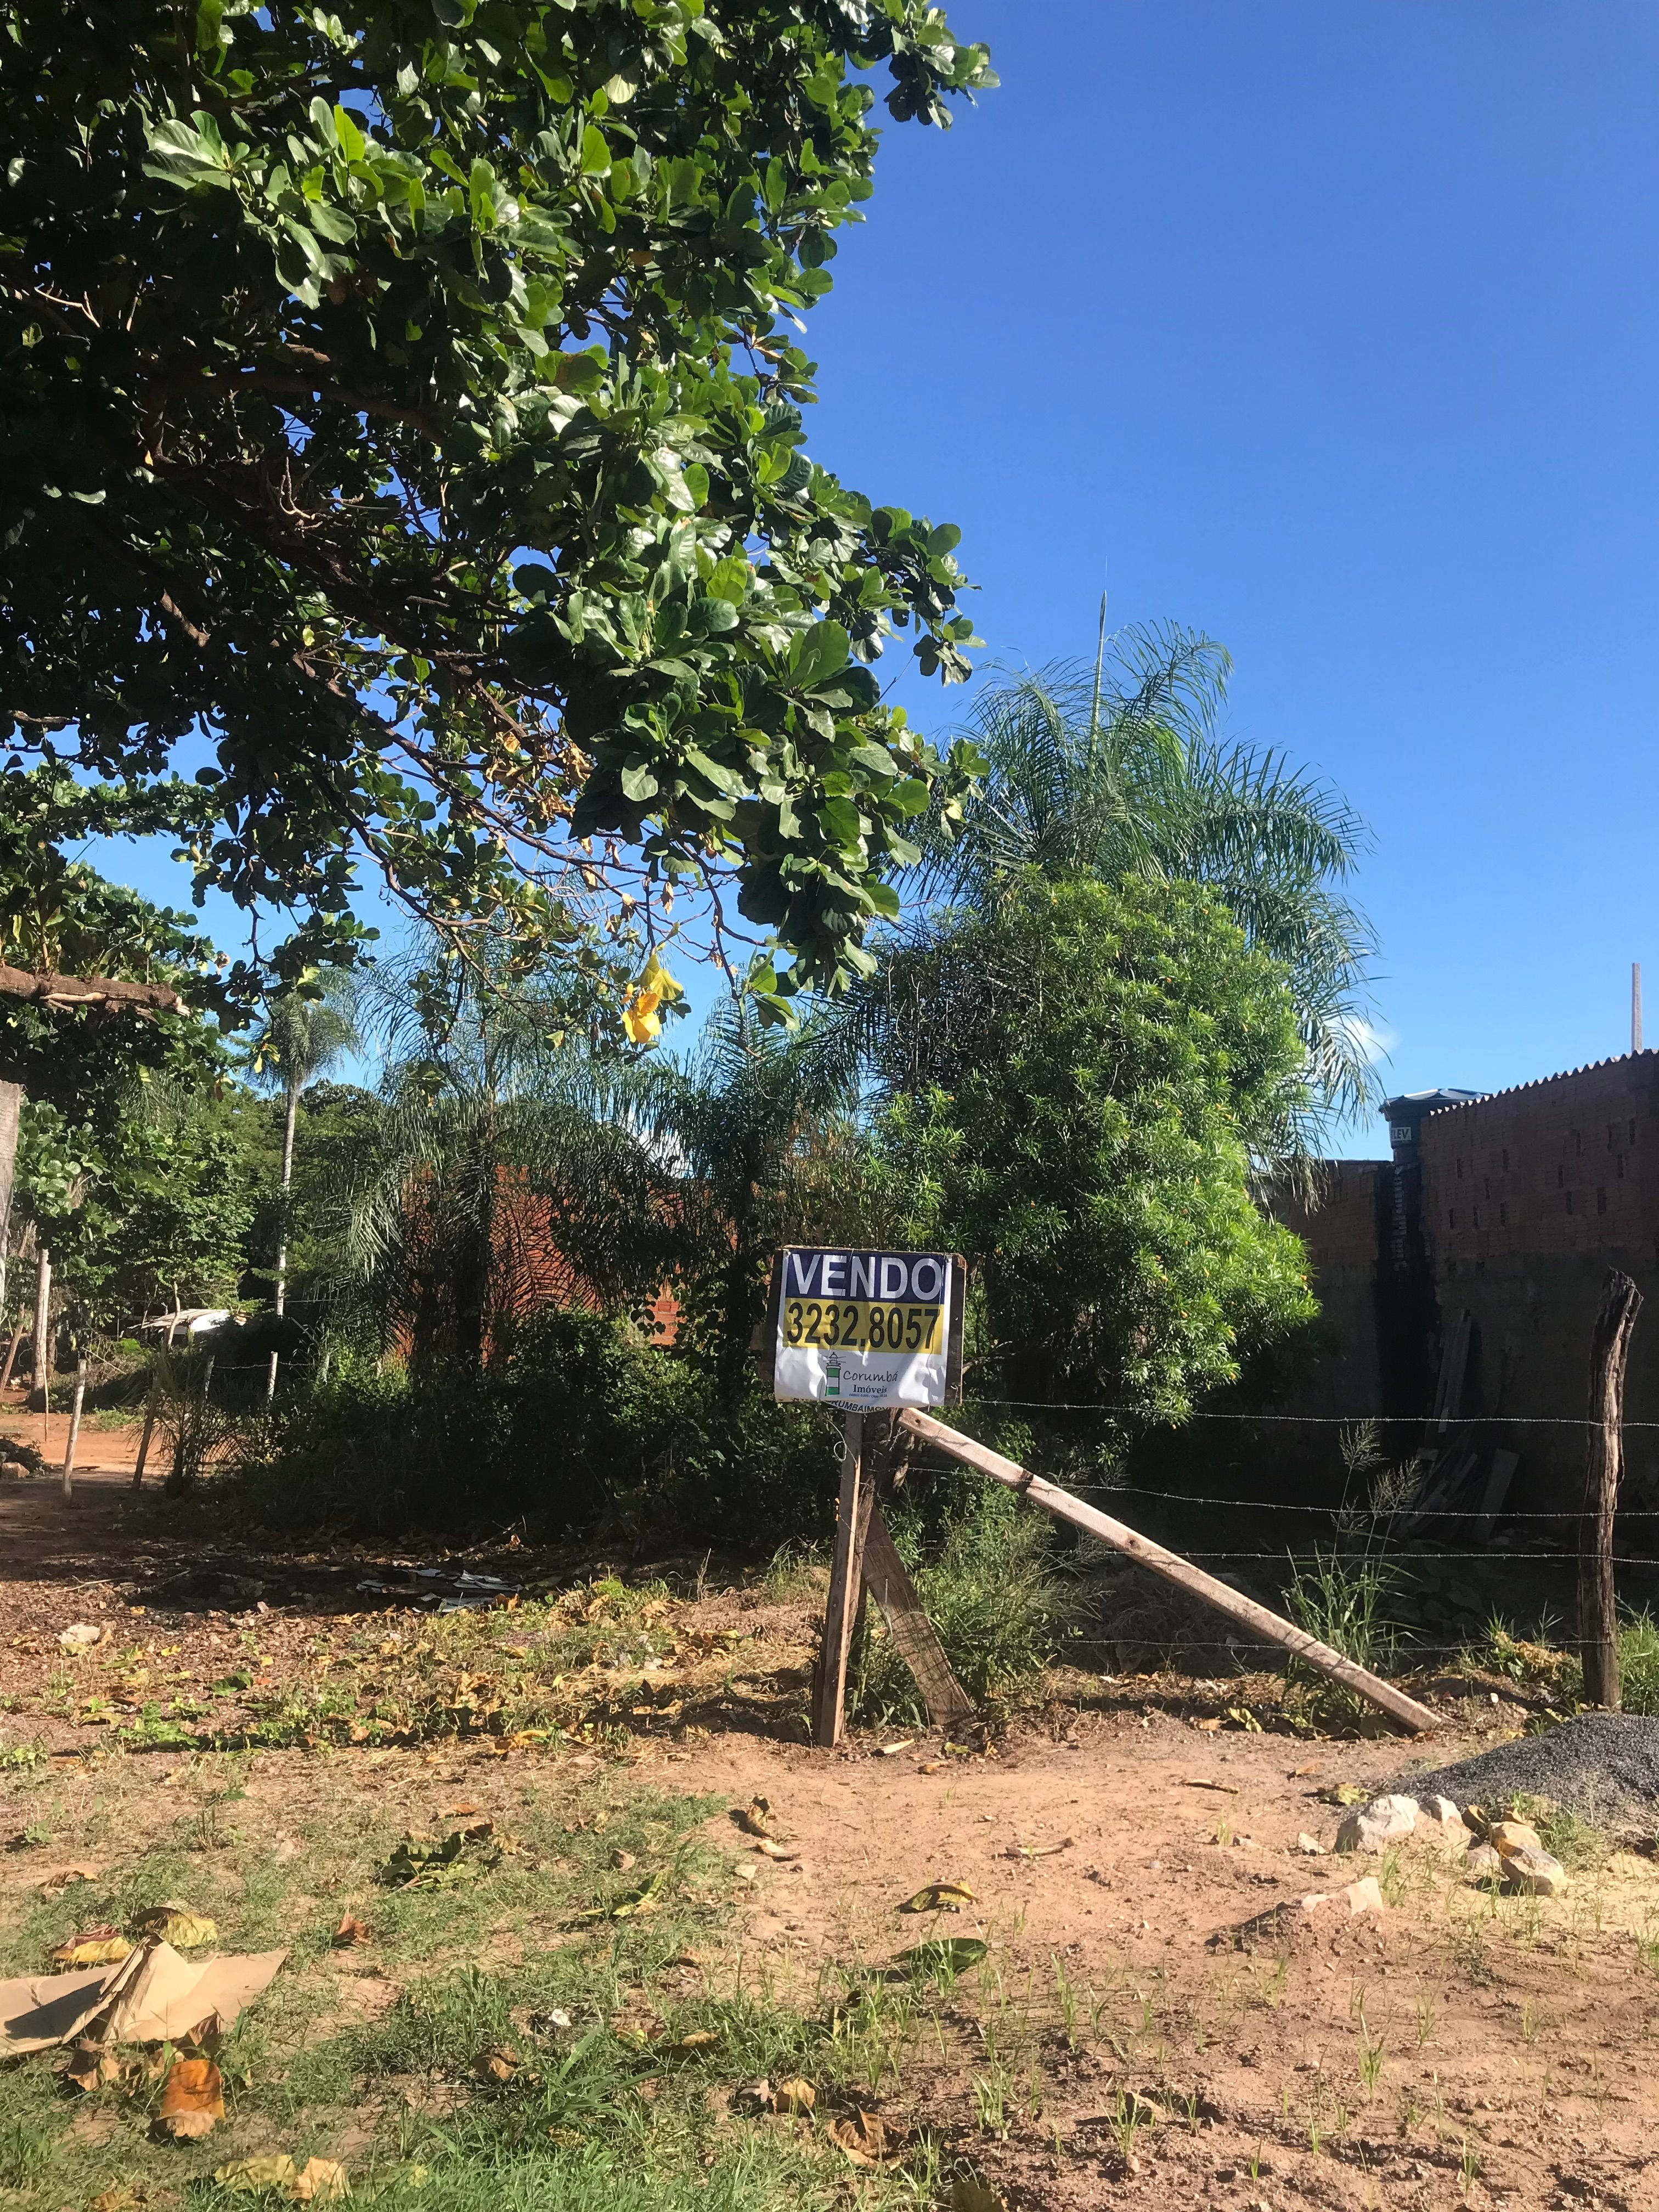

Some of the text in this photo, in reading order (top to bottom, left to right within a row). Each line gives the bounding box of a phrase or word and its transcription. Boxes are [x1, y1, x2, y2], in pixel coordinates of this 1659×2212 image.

[1391, 1128, 1409, 1139] LEV
[792, 1254, 942, 1300] VENDO
[787, 1302, 940, 1349] 3232.8057
[843, 1370, 898, 1382] Corumbá
[853, 1384, 887, 1393] Imóveis
